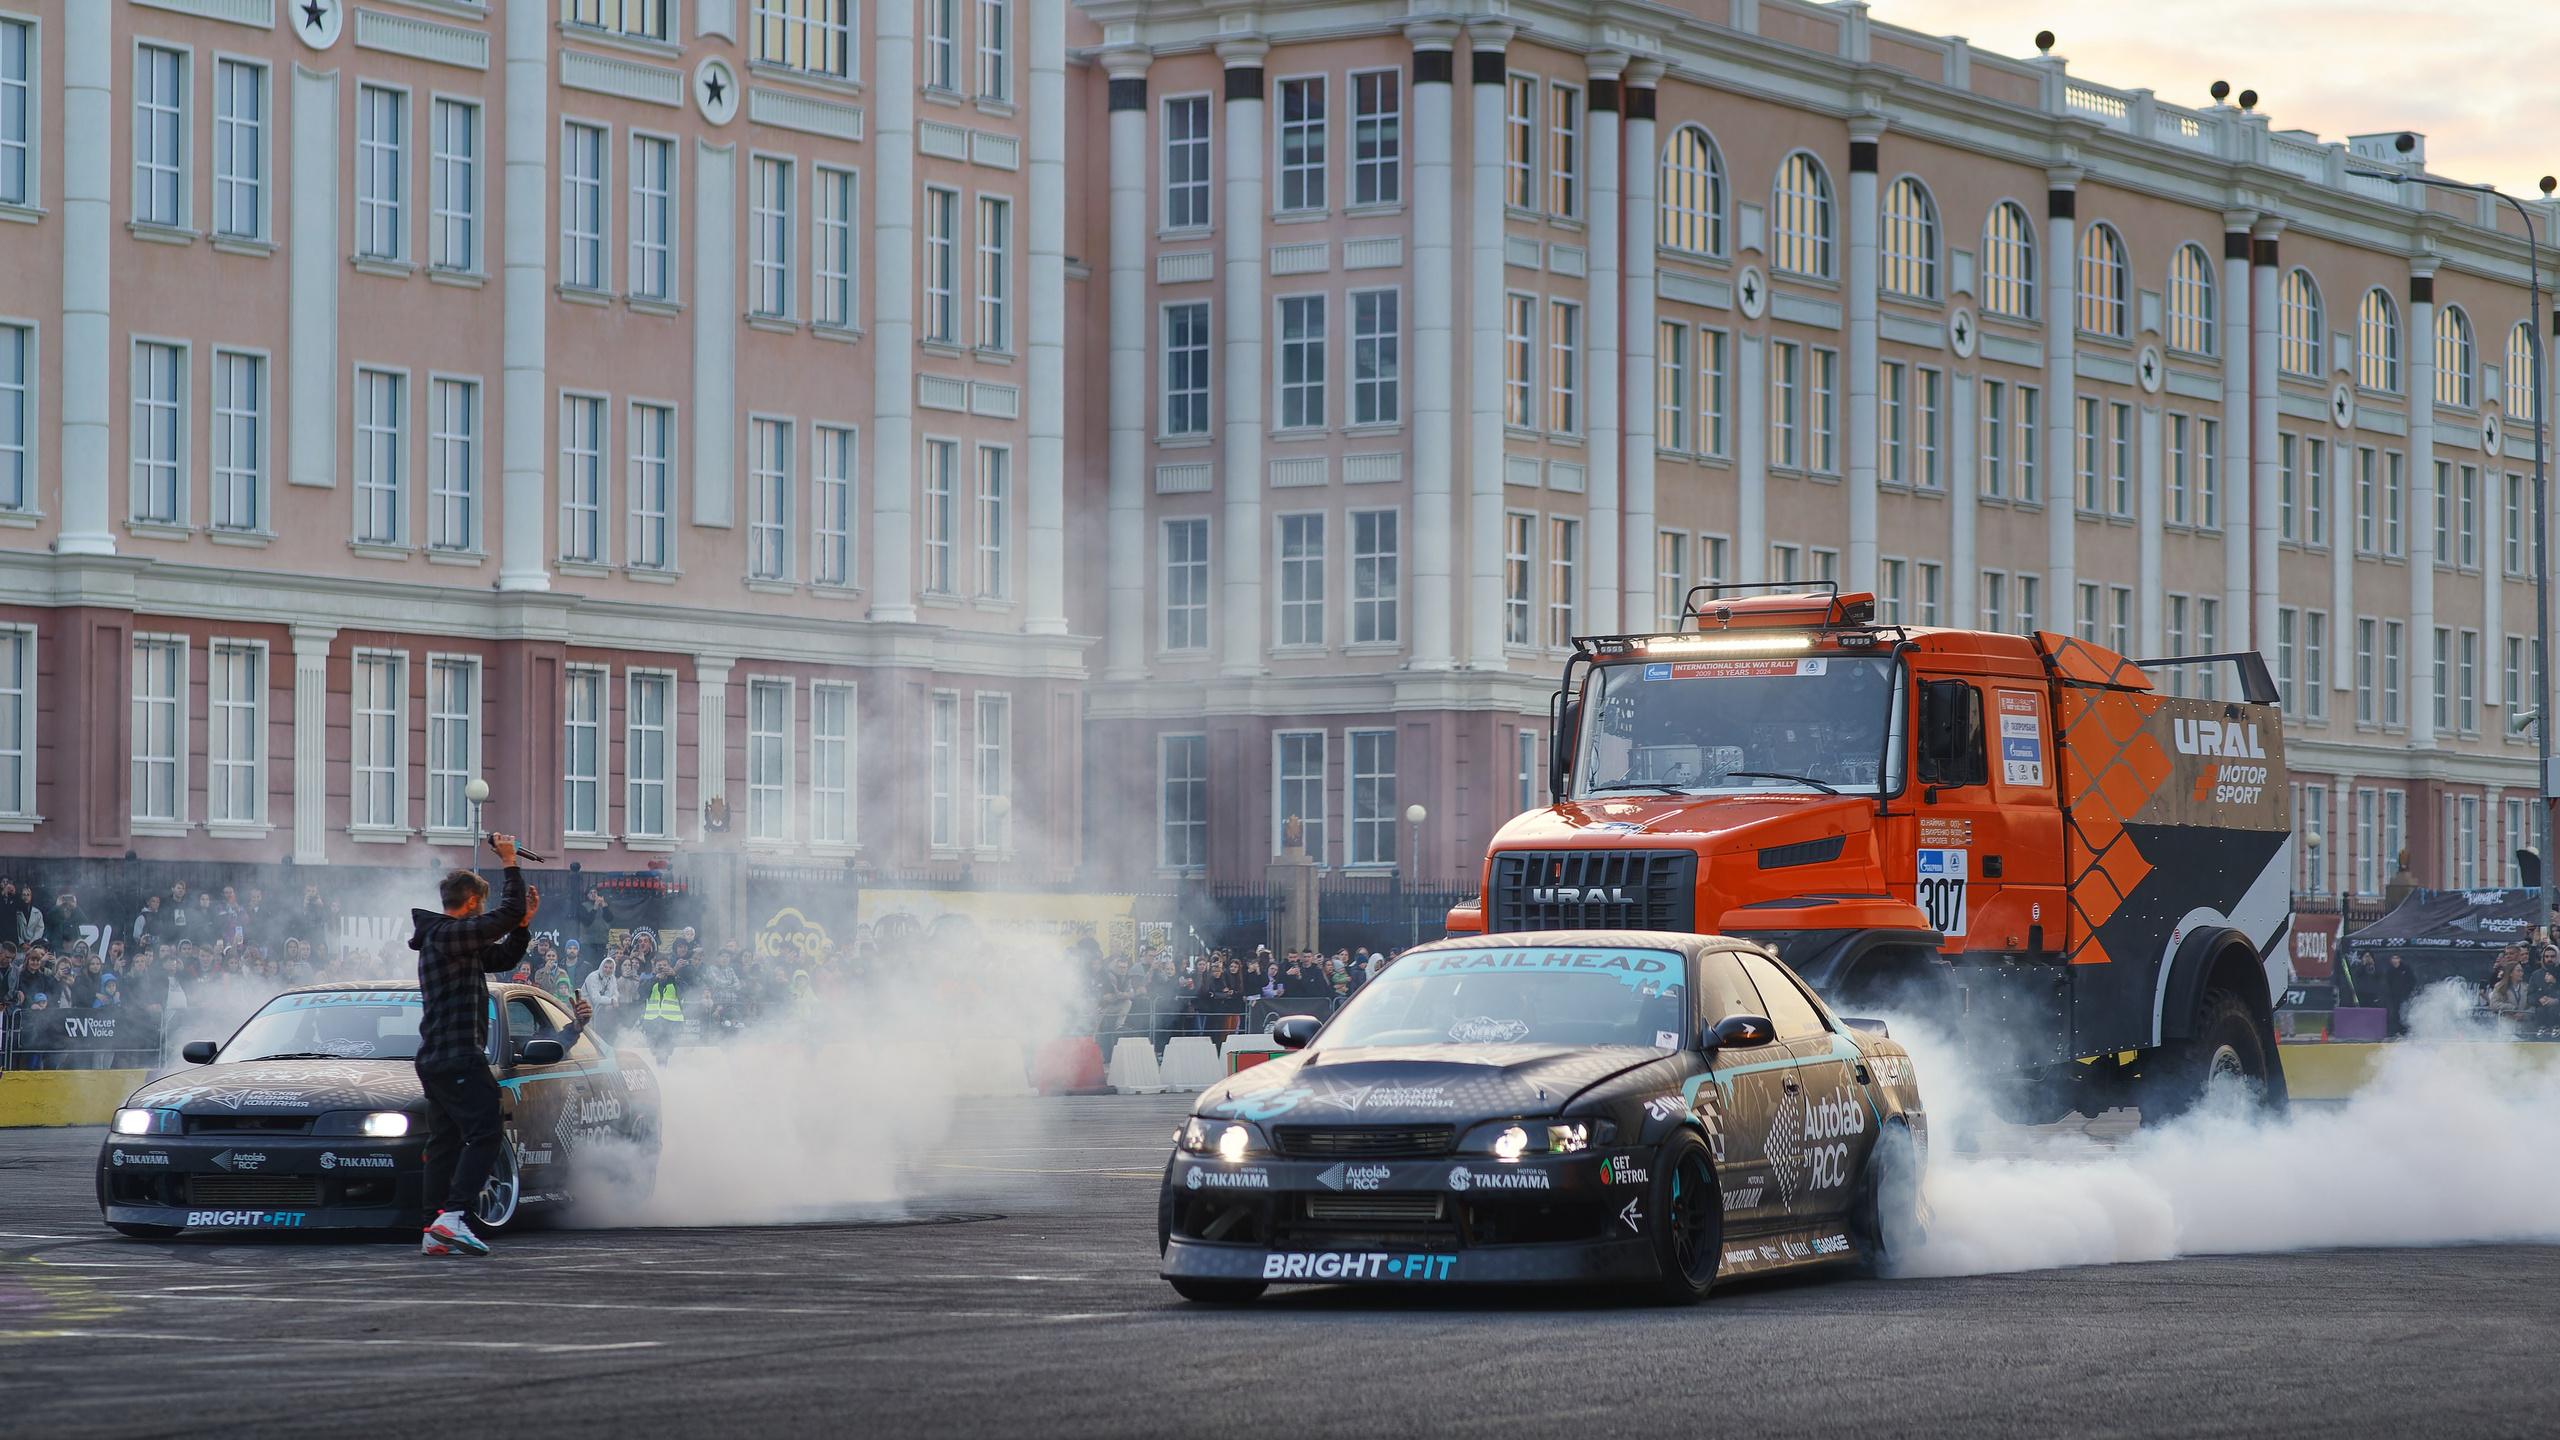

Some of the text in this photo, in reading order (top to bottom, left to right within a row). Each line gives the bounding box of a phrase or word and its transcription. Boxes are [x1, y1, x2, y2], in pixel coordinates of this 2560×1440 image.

[1675, 662, 1733, 671] INTERNATIONAL
[1734, 661, 1751, 669] SILK
[1771, 660, 1795, 668] RALLY
[2174, 718, 2267, 759] URAL
[2219, 764, 2267, 784] MOTOR
[2216, 784, 2262, 804] SPORT
[1533, 888, 1634, 903] URAL
[1920, 878, 1965, 931] 307
[2480, 918, 2528, 926] Autolab
[2489, 925, 2516, 933] RCC
[2296, 932, 2328, 962] ВХОД
[1417, 953, 1667, 974] TRAILHEAD
[293, 992, 423, 1007] TRAILHE
[88, 1018, 116, 1027] Rocket
[92, 1028, 114, 1037] Voice
[581, 1091, 621, 1125] Autolab
[1804, 1087, 1865, 1141] Autolab
[125, 1155, 169, 1165] TAKAYAMA
[233, 1152, 266, 1162] Autolab
[339, 1158, 394, 1167] TAKAYAMA
[1613, 1156, 1630, 1170] GET
[239, 1161, 258, 1170] RCC
[1346, 1165, 1390, 1180] Autolab
[1809, 1142, 1848, 1190] RCC
[1204, 1174, 1269, 1188] TAKAYAMA
[1353, 1177, 1378, 1190] RCC
[1474, 1172, 1550, 1189] TAKAYAMA
[1615, 1168, 1649, 1185] PETROL
[1723, 1188, 1763, 1211] TAKAYAMA
[186, 1211, 306, 1226] BRIGHT FIT
[1262, 1252, 1457, 1280] BRIGHT FIT
